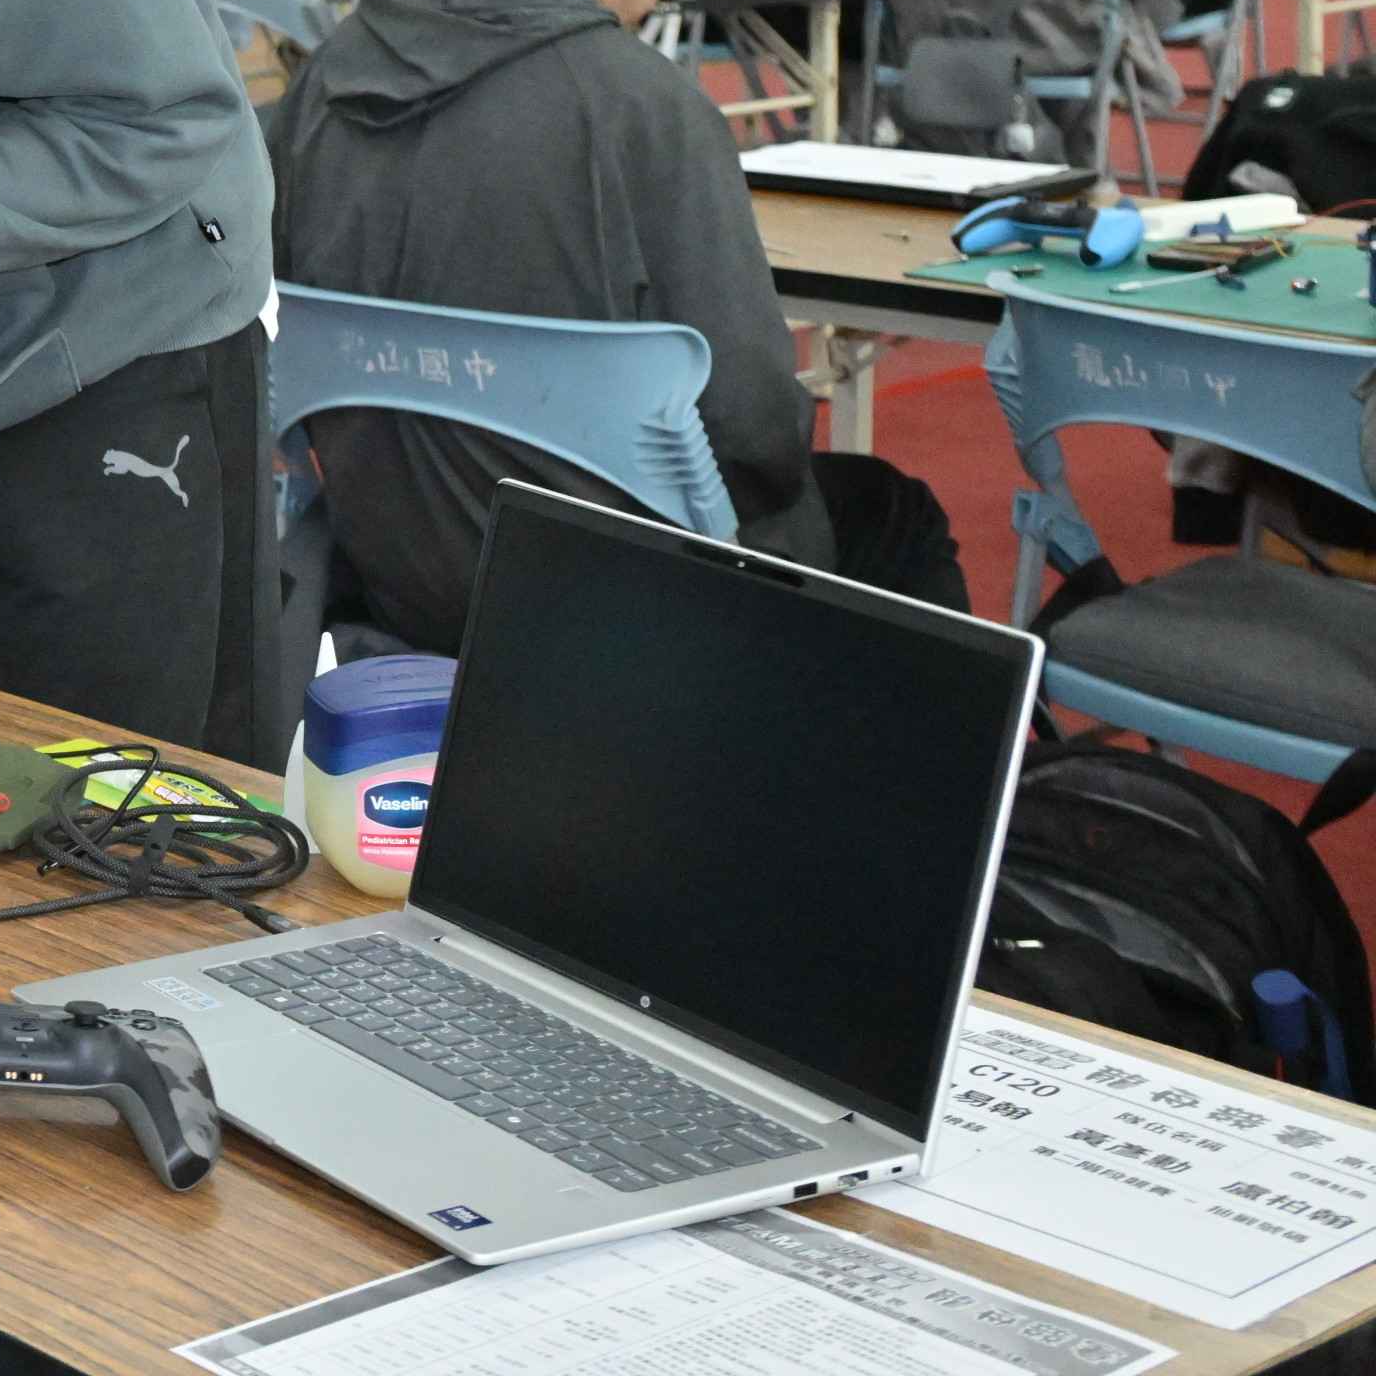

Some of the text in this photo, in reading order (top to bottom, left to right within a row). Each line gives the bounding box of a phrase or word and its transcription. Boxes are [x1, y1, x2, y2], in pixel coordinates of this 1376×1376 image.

[370, 796, 428, 811] Vaselin
[969, 1064, 1060, 1098] C120
[950, 1083, 1032, 1120] 易翰
